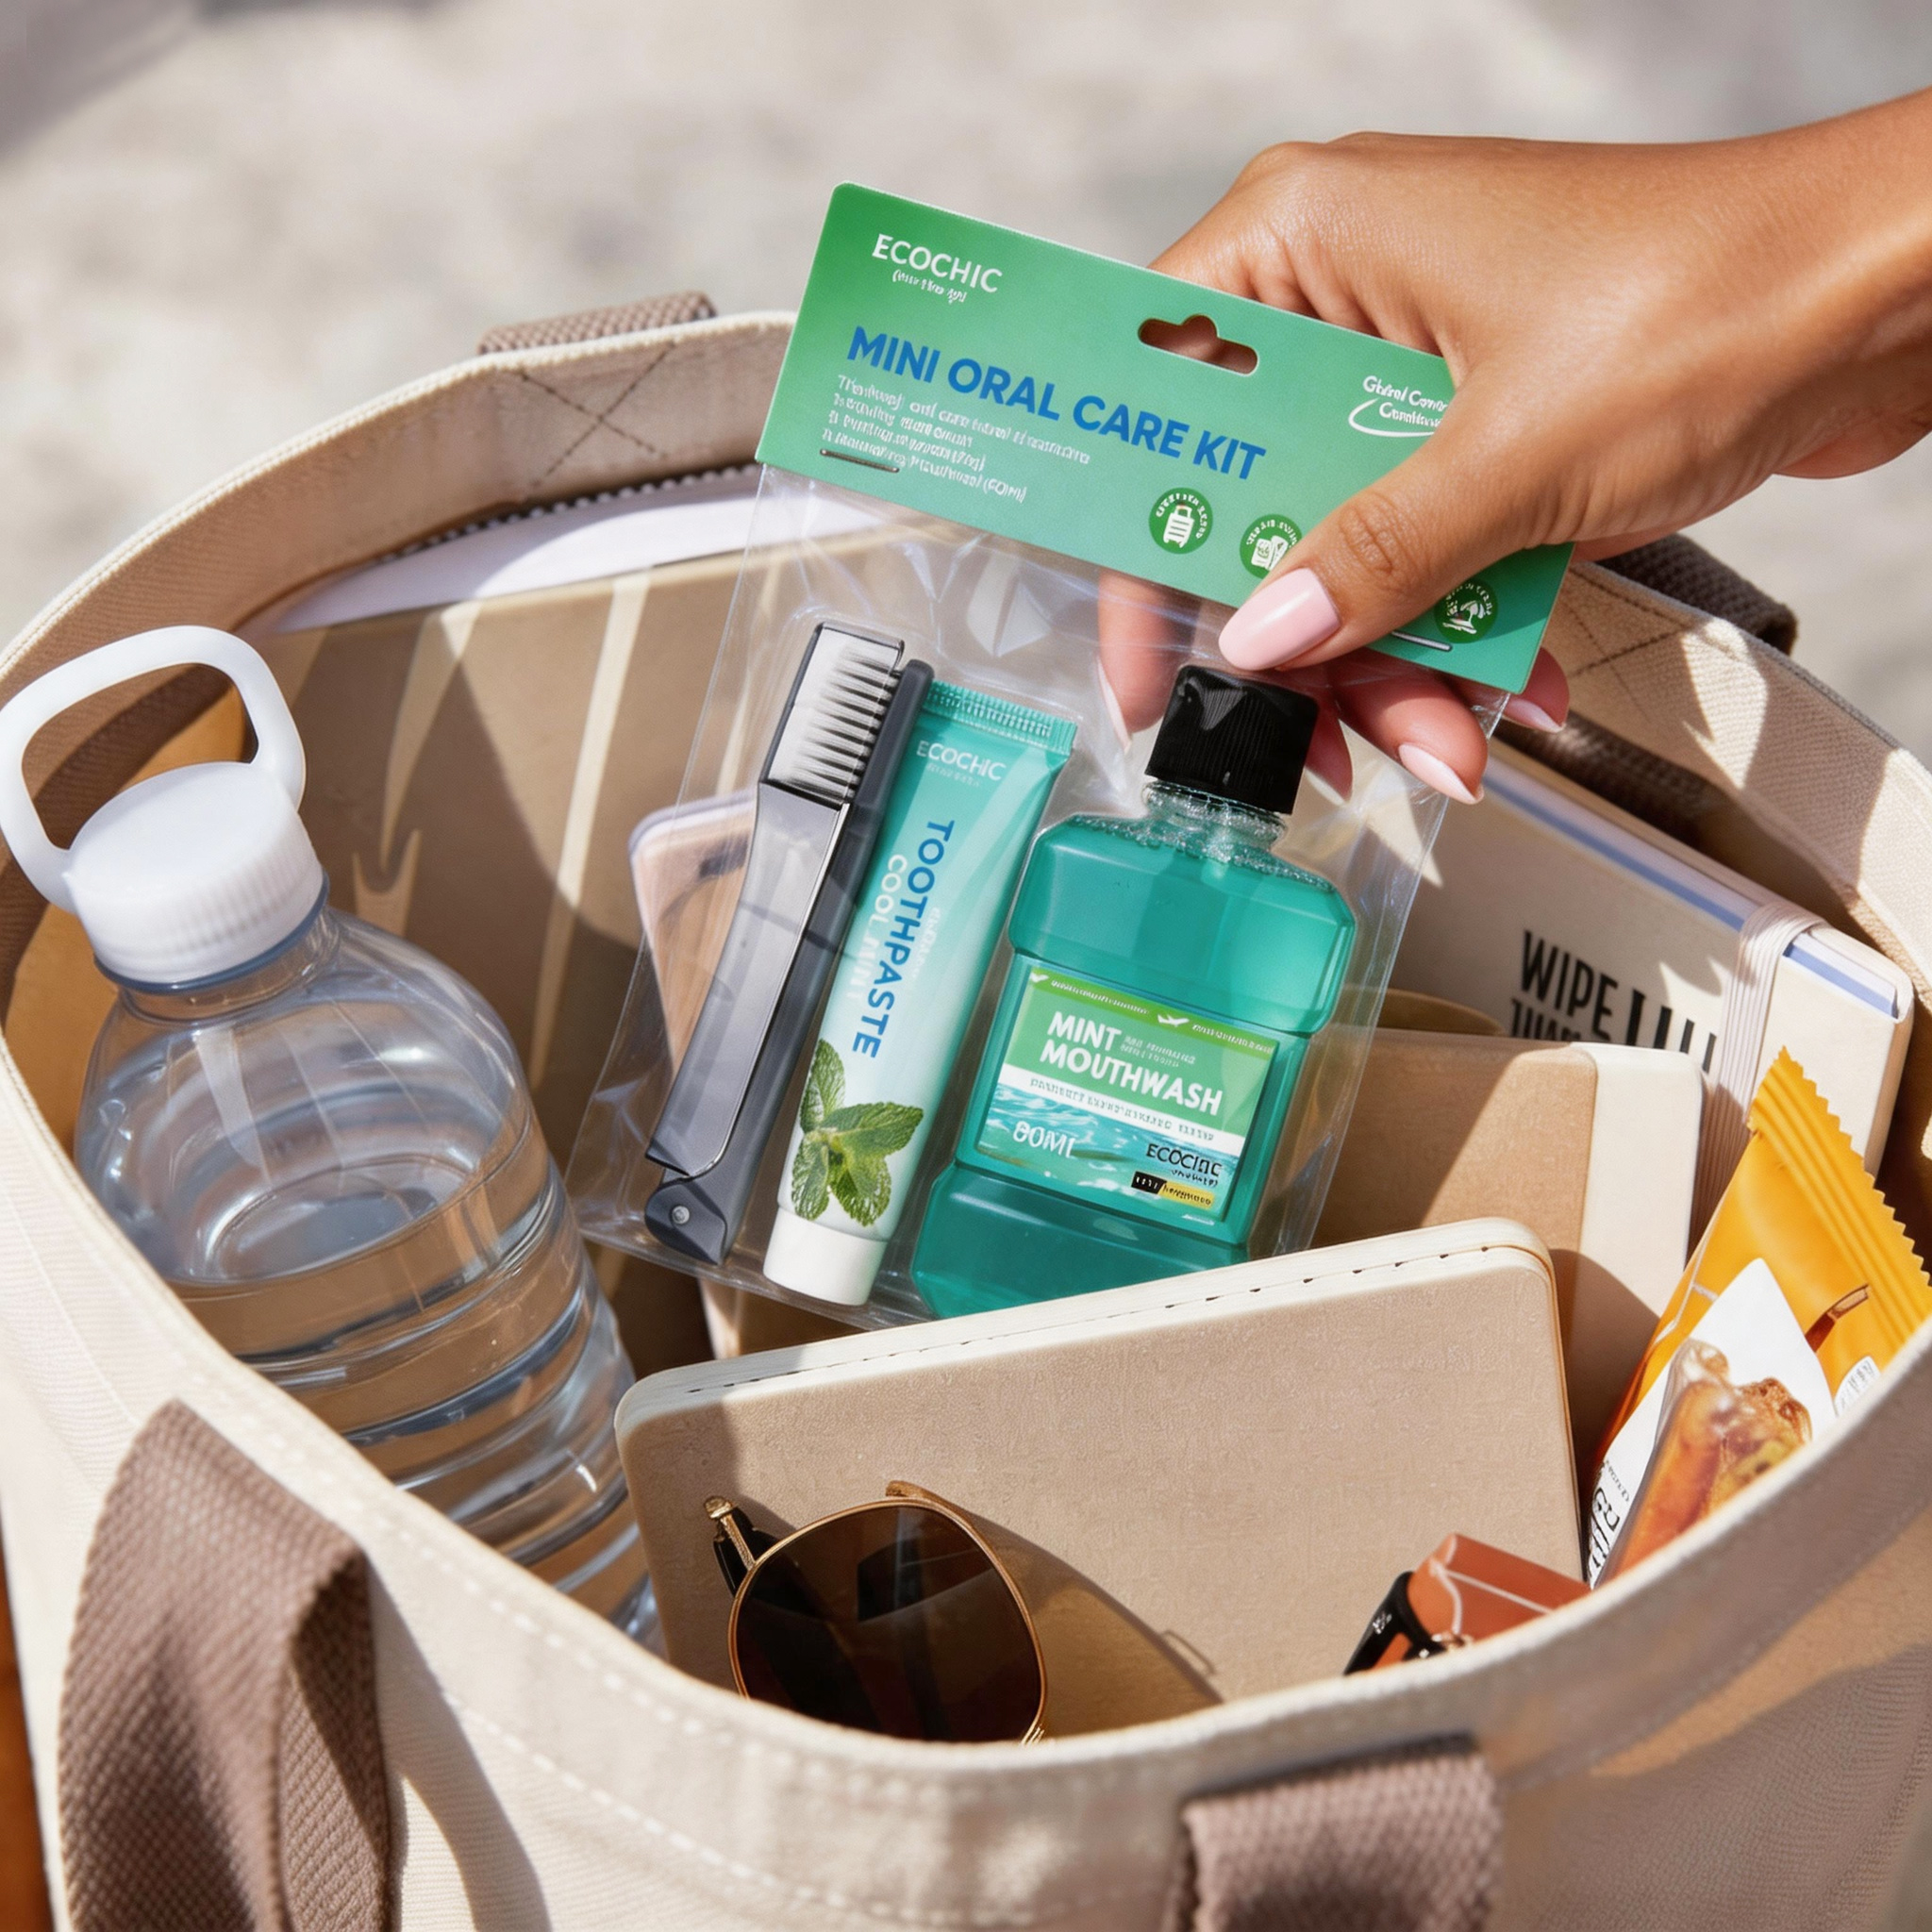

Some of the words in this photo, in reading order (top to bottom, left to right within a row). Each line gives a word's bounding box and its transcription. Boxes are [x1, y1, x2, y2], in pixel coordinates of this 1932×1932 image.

[872, 233, 1003, 293] ECOCHIC
[847, 325, 941, 383] MINI
[947, 358, 1060, 421] ORAL
[1073, 394, 1191, 459] CARE
[1192, 429, 1267, 480] KIT
[916, 740, 1007, 781] ECOCHIC
[868, 854, 908, 924] COOL
[852, 820, 955, 1058] TOOTHPASTE
[1521, 929, 1618, 1041] WIPE
[1047, 1011, 1122, 1052] MINT
[1040, 1039, 1223, 1116] MOUTHWASH
